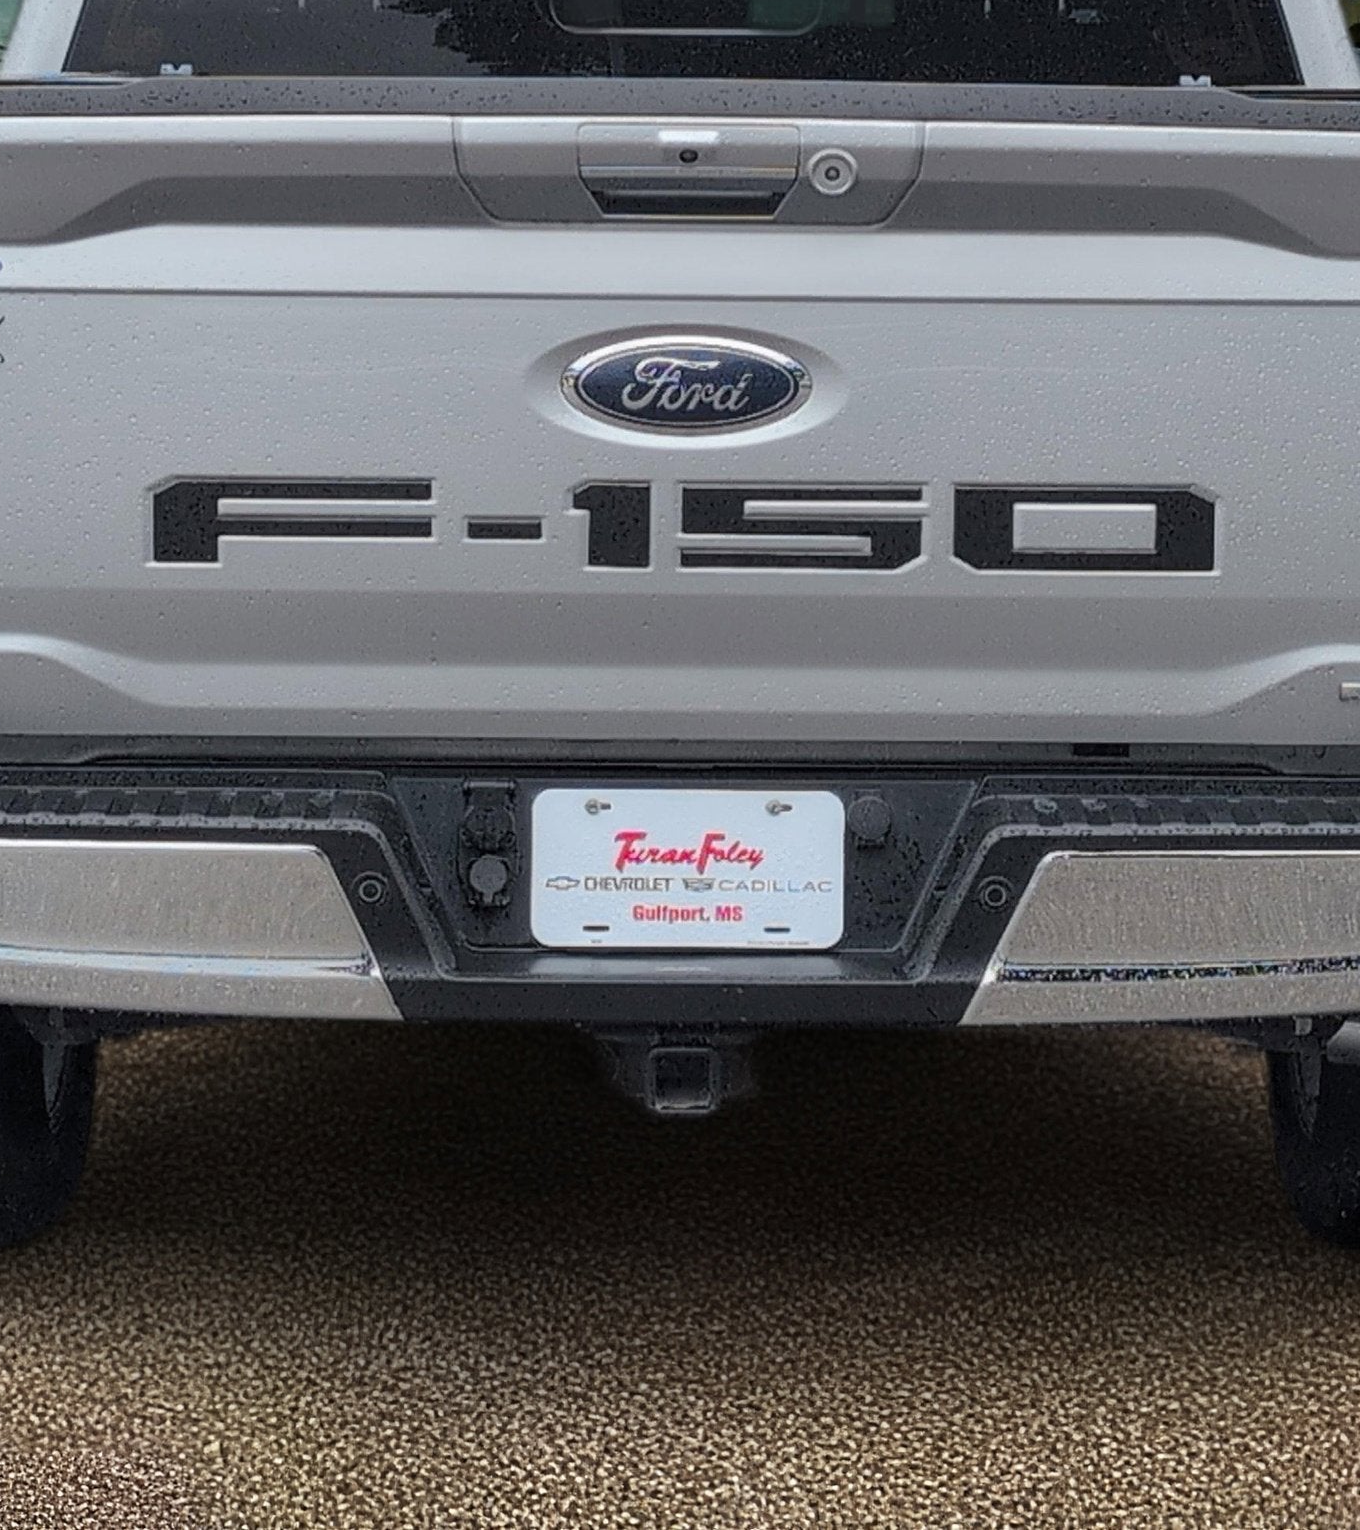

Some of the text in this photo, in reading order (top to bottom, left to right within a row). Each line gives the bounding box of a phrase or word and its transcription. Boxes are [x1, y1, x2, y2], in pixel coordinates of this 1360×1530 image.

[622, 357, 752, 412] Ford
[147, 475, 1221, 574] F-150
[583, 877, 673, 892] CHEVROLET
[718, 878, 833, 893] CADILLAC
[715, 905, 743, 921] MS
